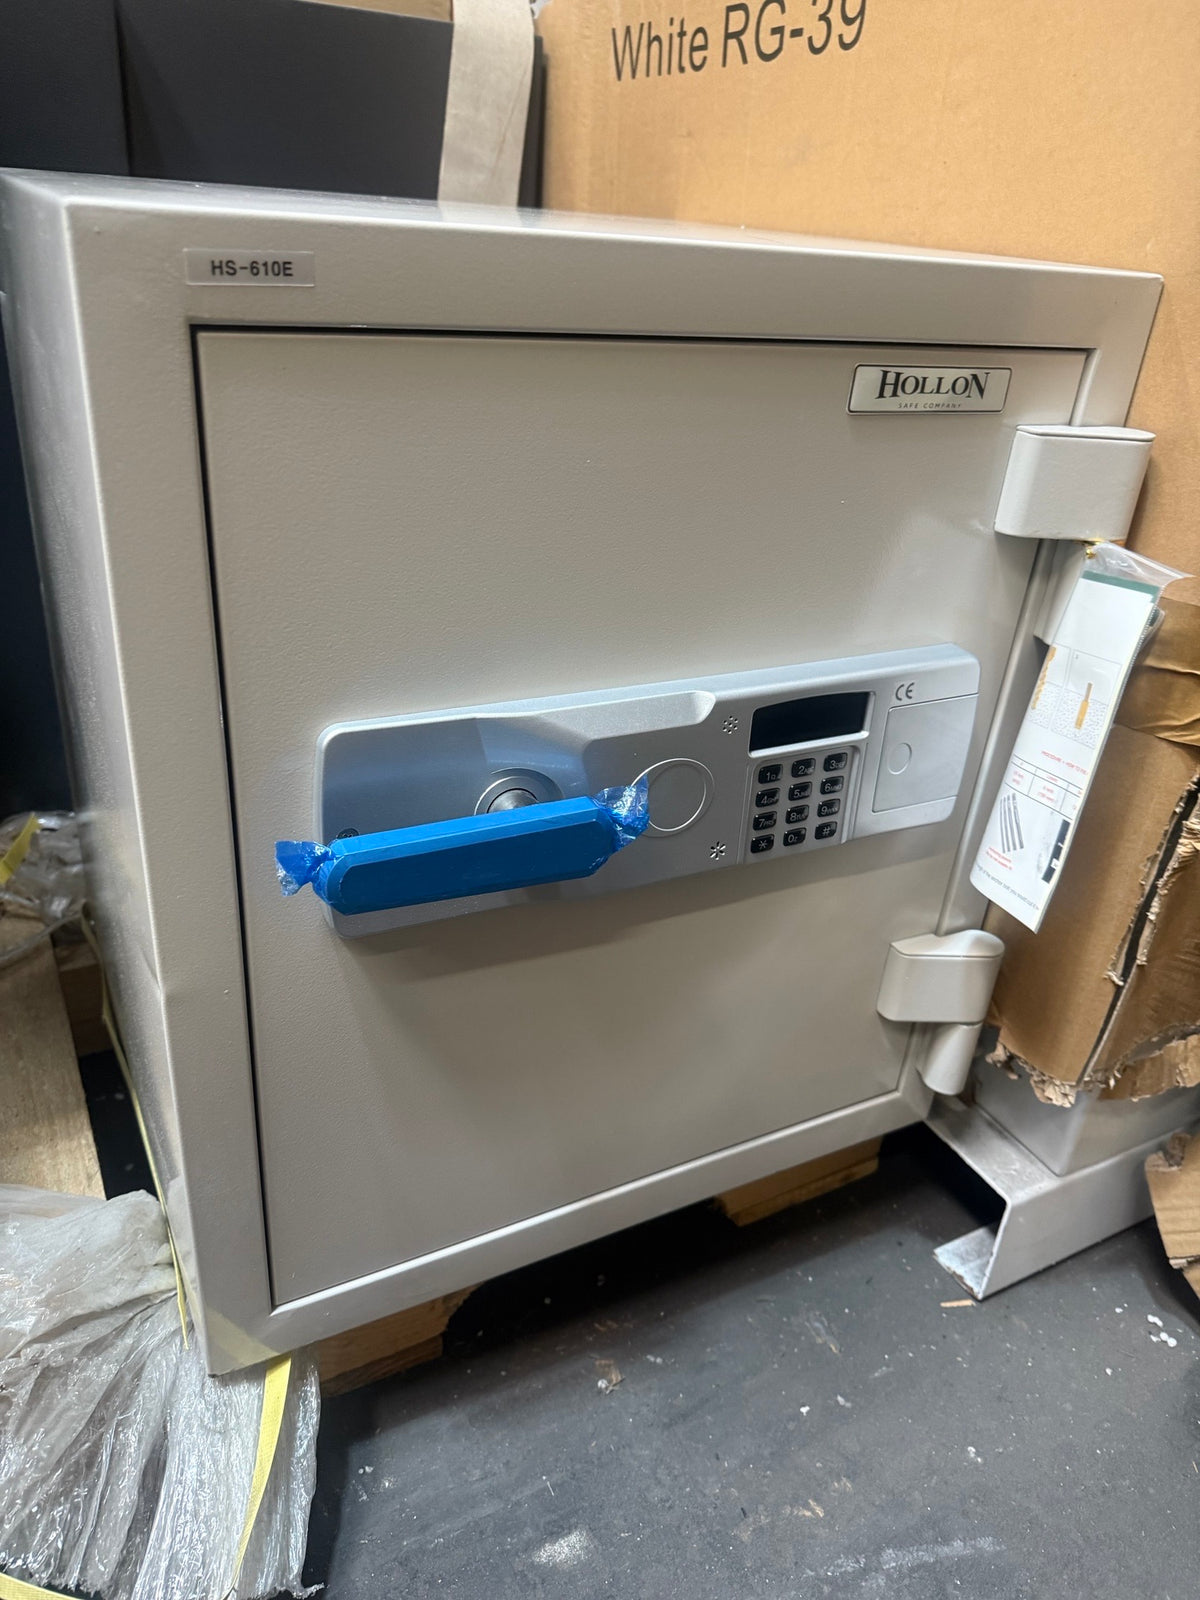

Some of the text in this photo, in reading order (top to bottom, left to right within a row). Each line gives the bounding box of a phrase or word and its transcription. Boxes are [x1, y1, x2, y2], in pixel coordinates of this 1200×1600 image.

[611, 0, 867, 82] White RG-39
[210, 259, 294, 277] HS-610E
[874, 369, 991, 400] HOLLON
